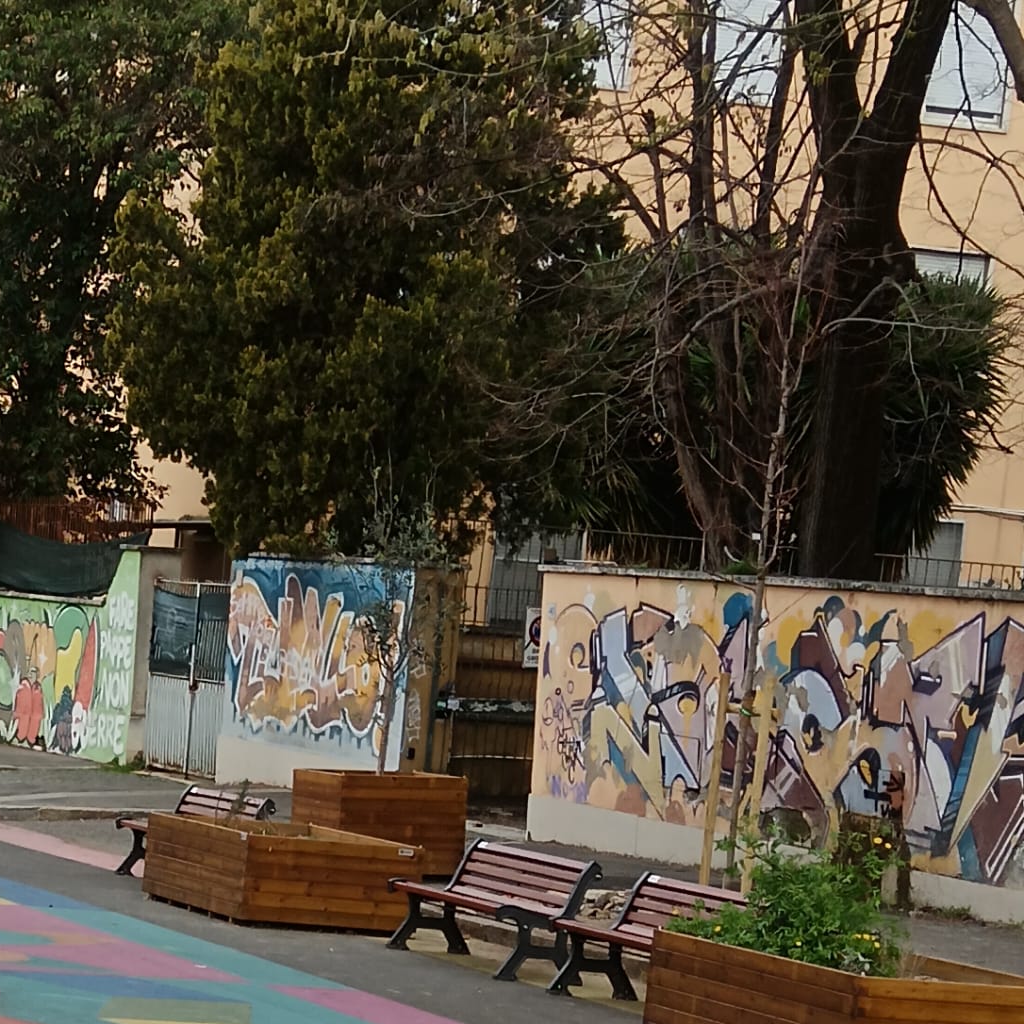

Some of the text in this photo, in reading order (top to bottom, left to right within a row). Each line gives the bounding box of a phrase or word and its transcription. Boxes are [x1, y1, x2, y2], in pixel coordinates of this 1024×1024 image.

[108, 591, 135, 632] FARE
[99, 667, 130, 711] NON
[71, 701, 126, 757] GUERRE
